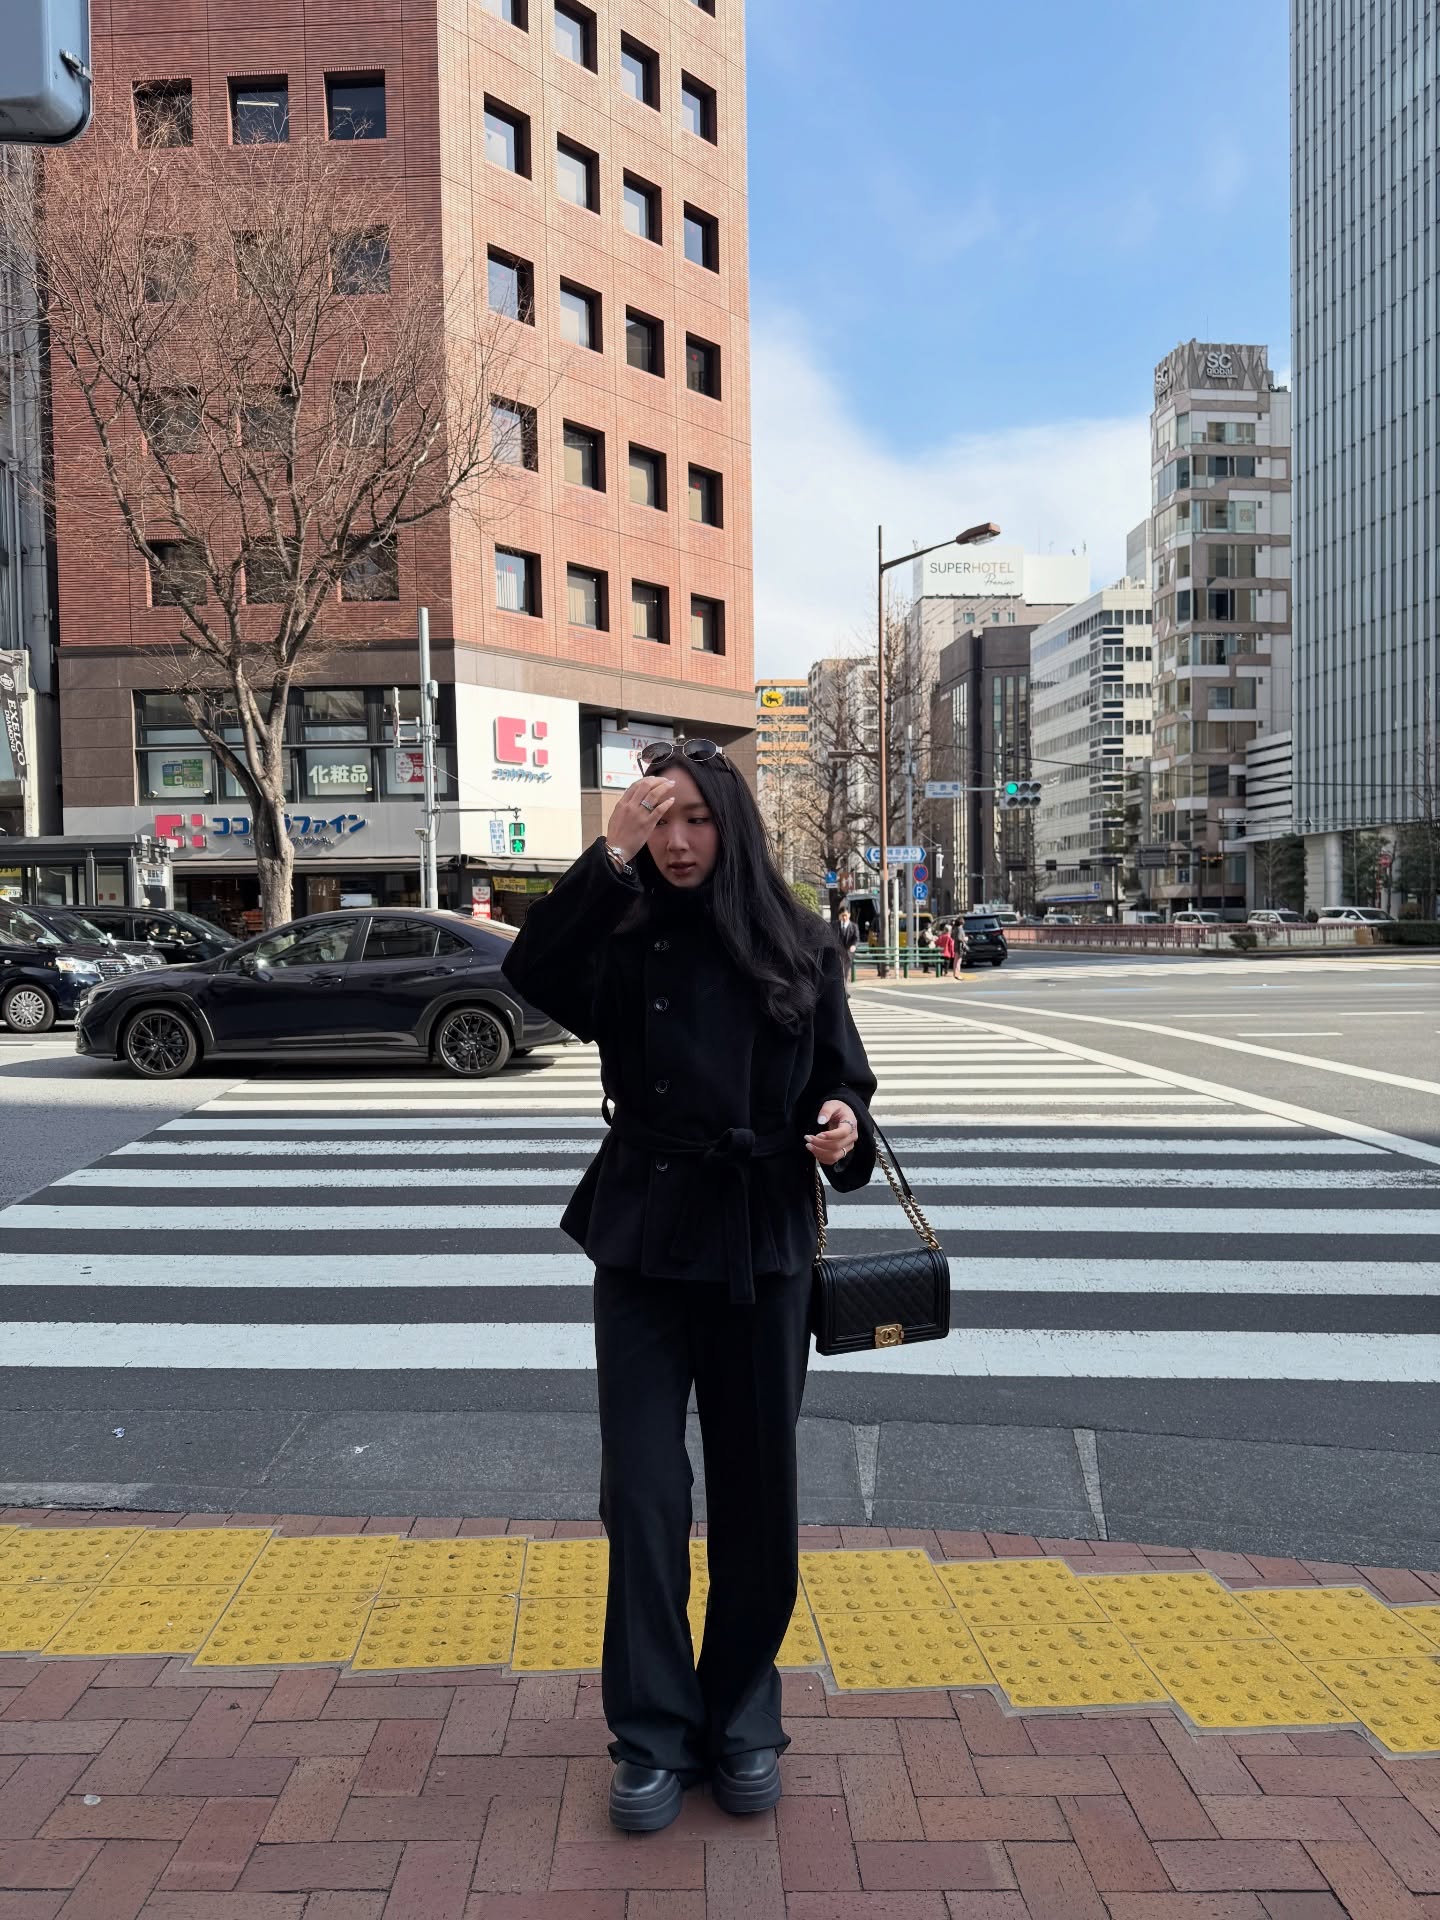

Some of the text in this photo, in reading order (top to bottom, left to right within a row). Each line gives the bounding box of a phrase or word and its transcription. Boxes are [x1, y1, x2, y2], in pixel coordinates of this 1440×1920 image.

[1207, 352, 1232, 368] SC
[1207, 367, 1233, 377] global
[929, 562, 1015, 574] SUPERHOTEL
[4, 709, 16, 752] DIAMOND
[7, 698, 26, 766] EXELCO
[309, 764, 368, 784] 化粧品
[212, 814, 367, 836] ココファイン
